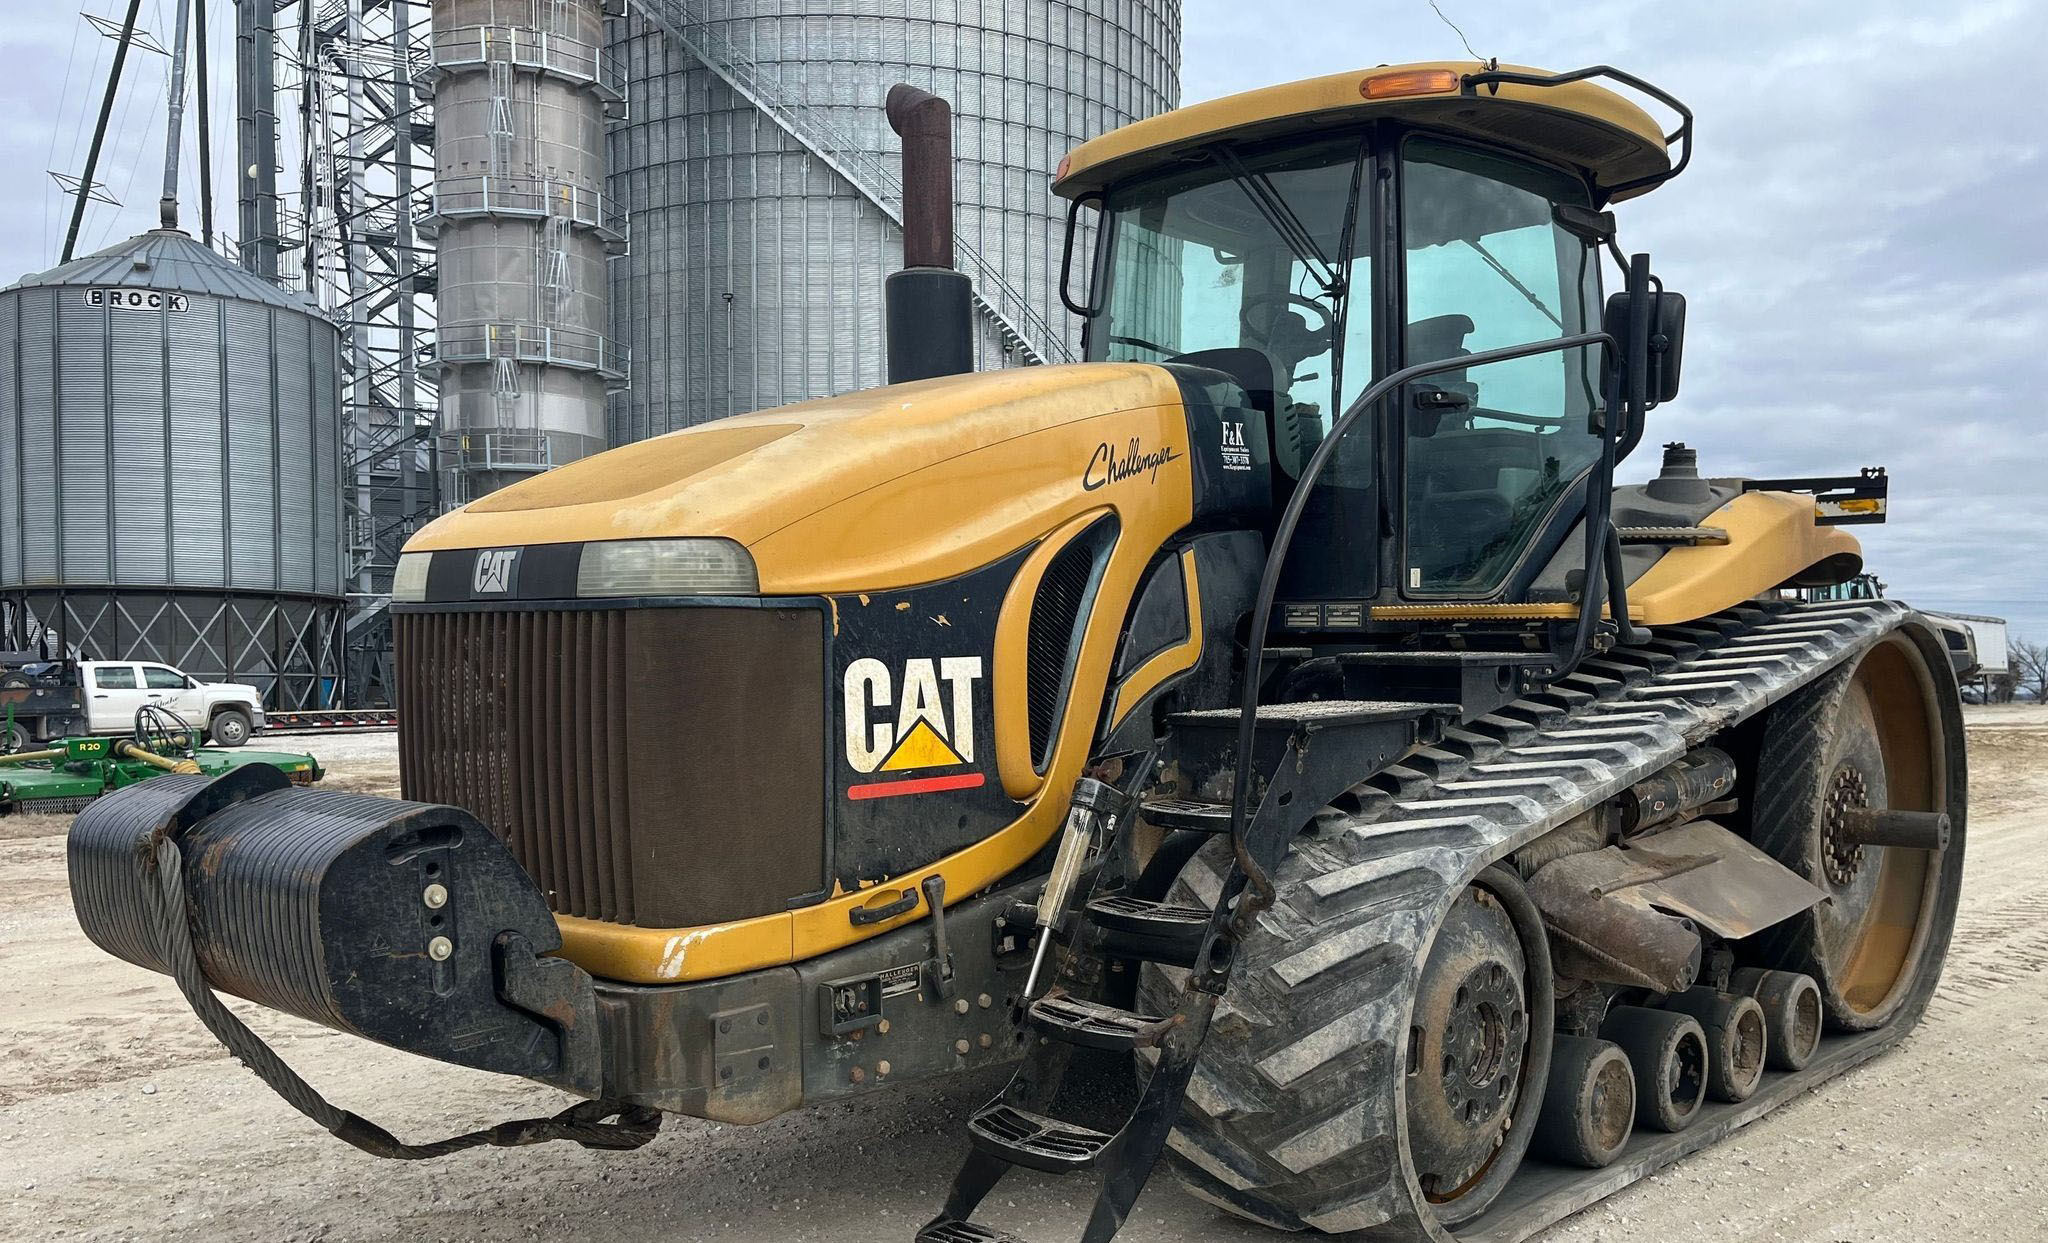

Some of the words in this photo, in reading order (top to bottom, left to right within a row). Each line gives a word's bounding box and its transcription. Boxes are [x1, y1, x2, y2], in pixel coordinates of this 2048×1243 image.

[91, 290, 181, 310] BROCK
[1221, 421, 1245, 446] F&K
[1083, 437, 1184, 491] Challenger
[474, 550, 517, 593] CAT
[843, 656, 983, 774] CAT
